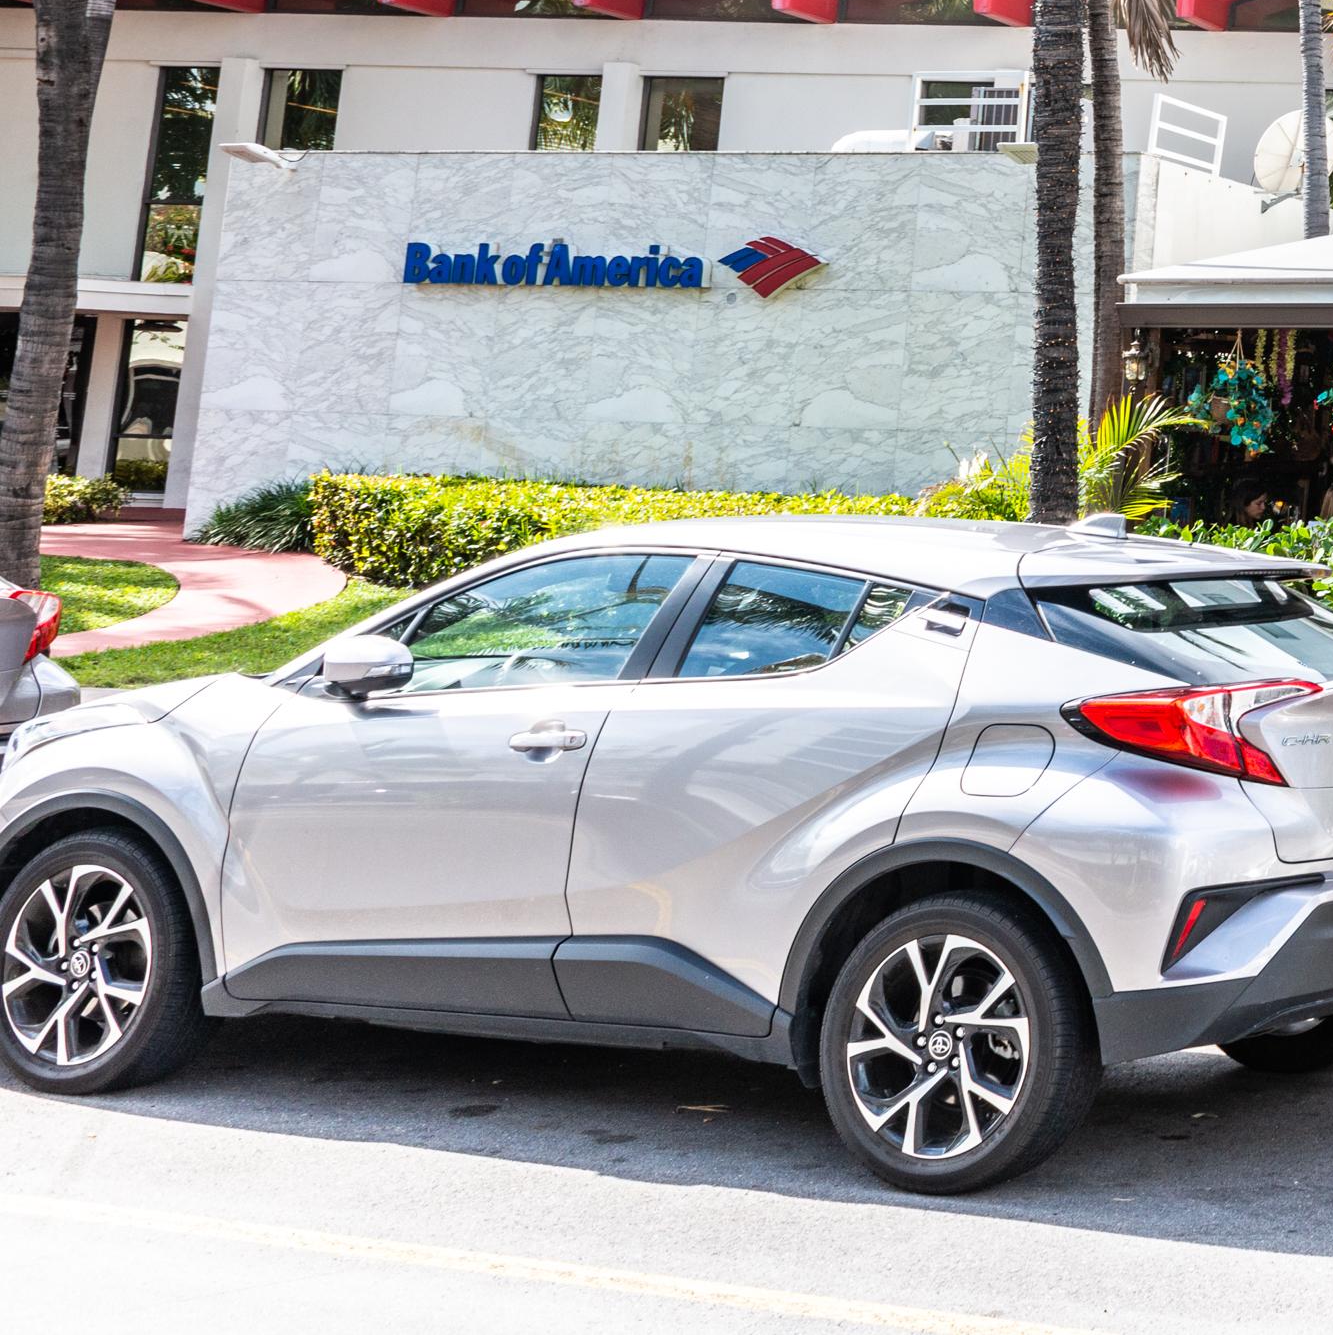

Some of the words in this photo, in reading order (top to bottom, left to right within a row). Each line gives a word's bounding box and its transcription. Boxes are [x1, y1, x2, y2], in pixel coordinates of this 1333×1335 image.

[403, 242, 500, 284] Bank
[501, 242, 545, 285] of
[543, 243, 707, 288] America
